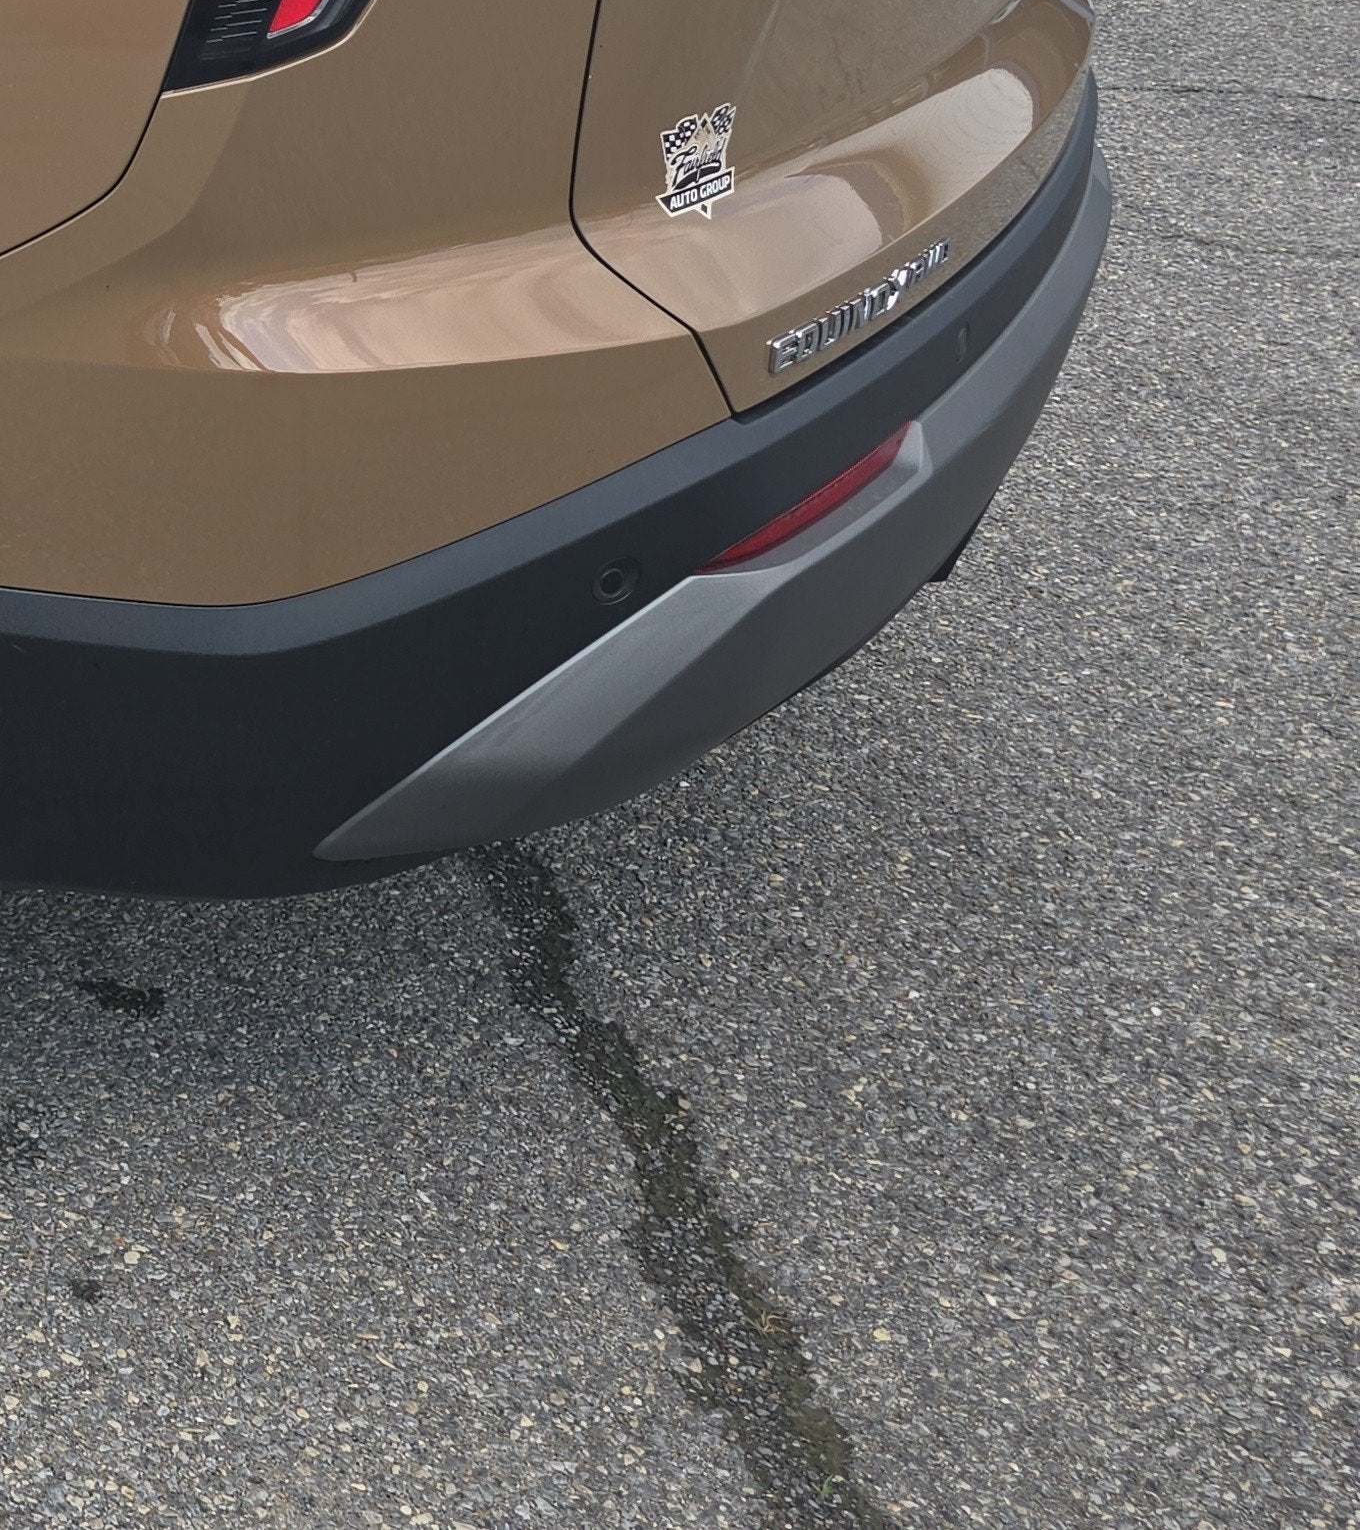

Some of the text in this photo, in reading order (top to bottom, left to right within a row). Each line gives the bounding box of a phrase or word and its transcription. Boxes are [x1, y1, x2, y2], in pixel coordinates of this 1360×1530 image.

[669, 174, 732, 211] AUTO GROUP
[766, 267, 910, 376] EQUINOX
